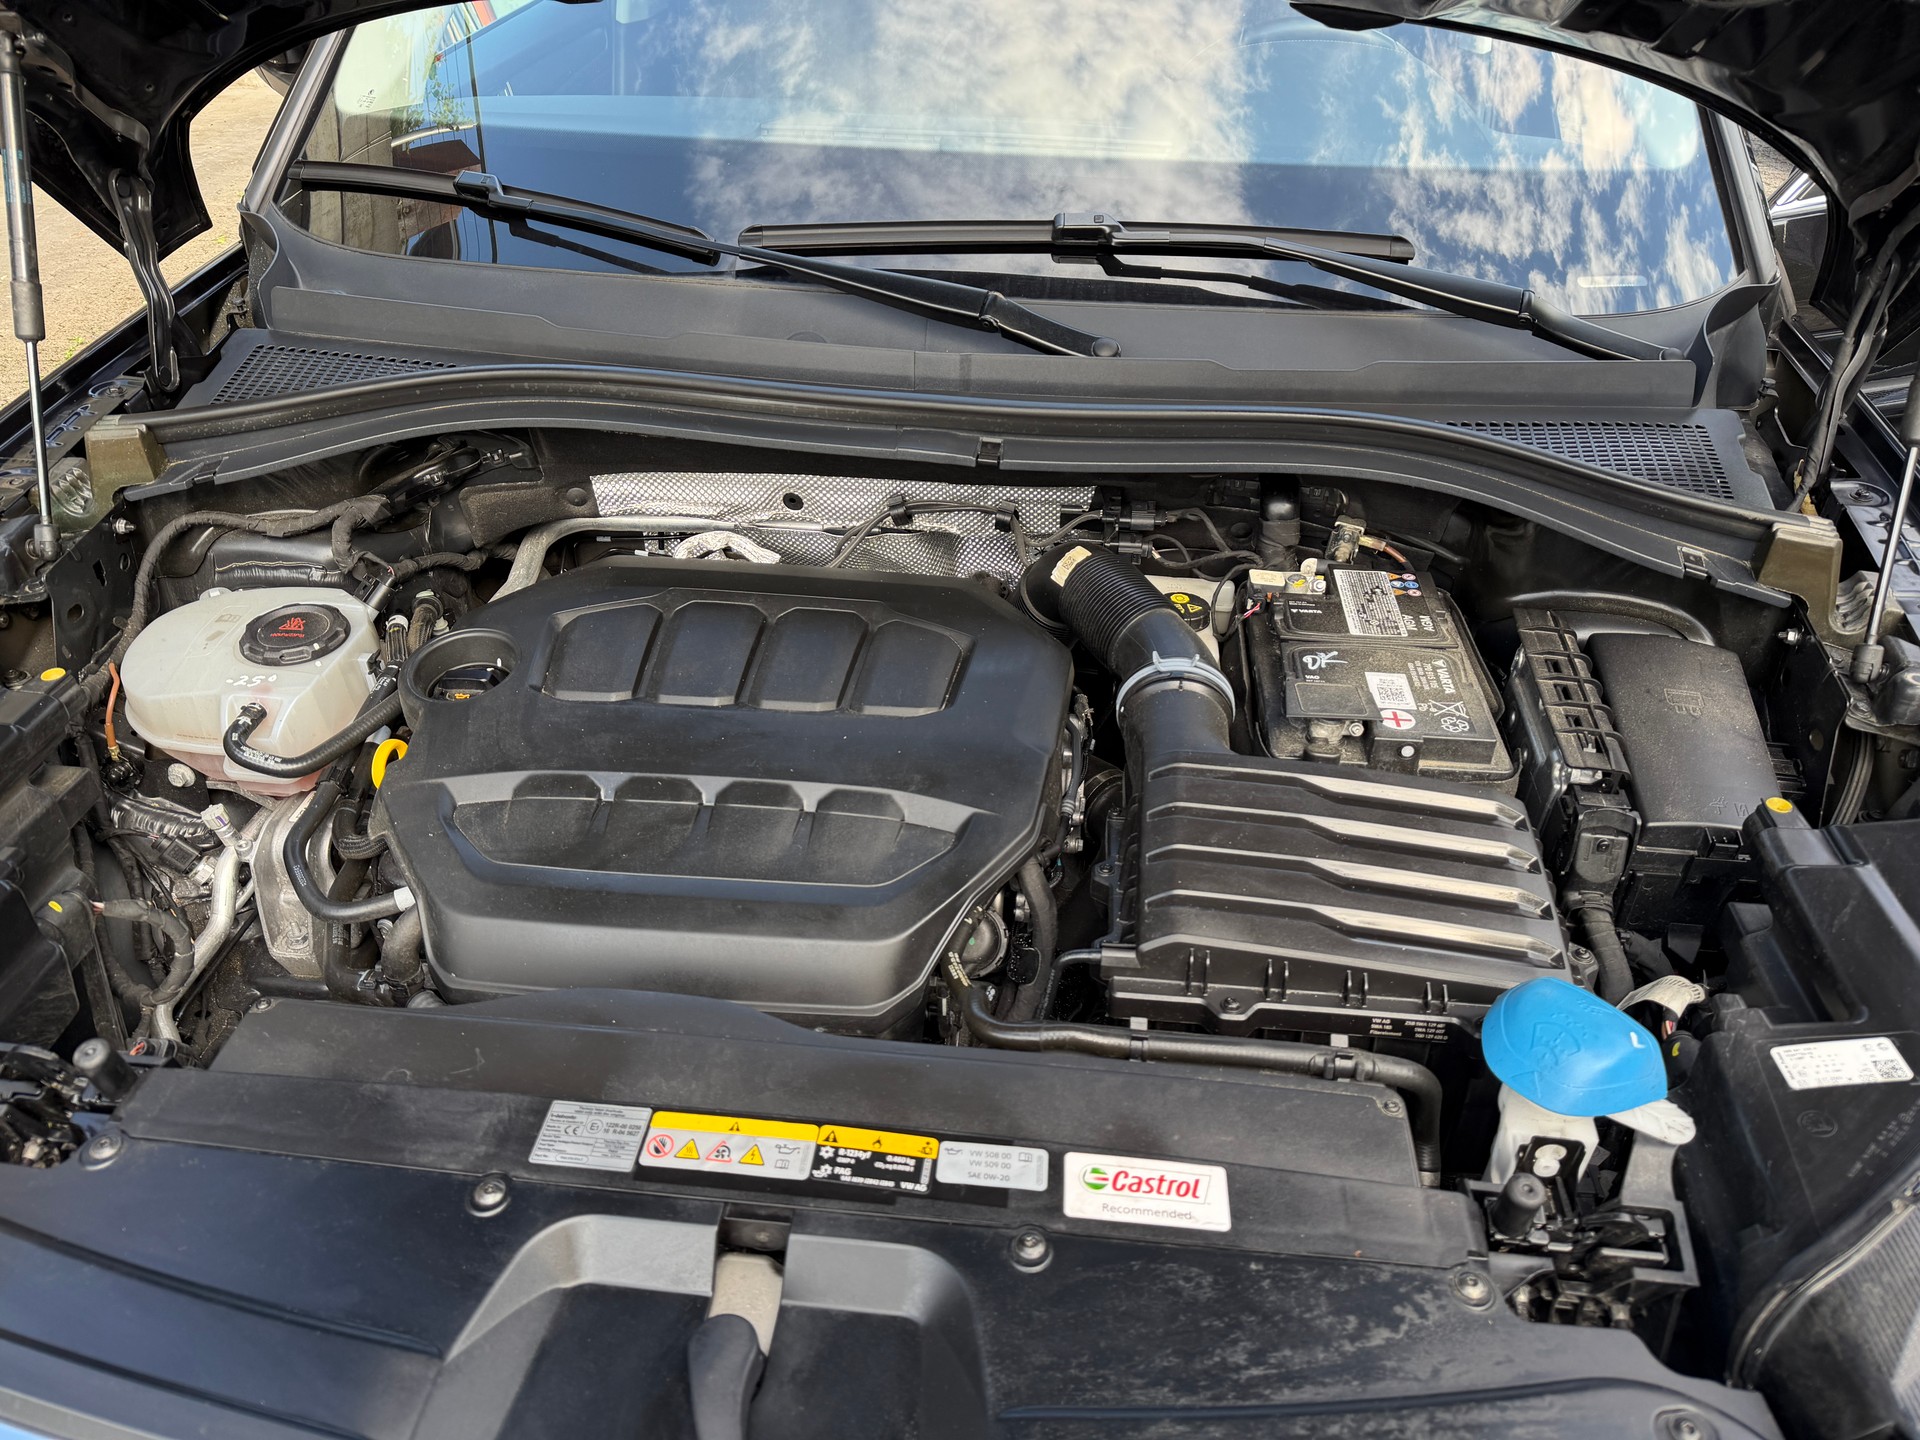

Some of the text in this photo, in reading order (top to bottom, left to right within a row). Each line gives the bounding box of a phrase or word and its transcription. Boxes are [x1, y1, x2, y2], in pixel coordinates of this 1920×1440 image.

[1436, 668, 1456, 694] VARTA
[837, 1148, 872, 1160] R-1234yf
[985, 1151, 999, 1159] 508
[833, 1166, 852, 1176] PAG
[983, 1173, 1011, 1181] 0W-20
[900, 1181, 928, 1192] VW AG
[1111, 1170, 1200, 1199] Castrol
[1102, 1203, 1192, 1220] Recommended
